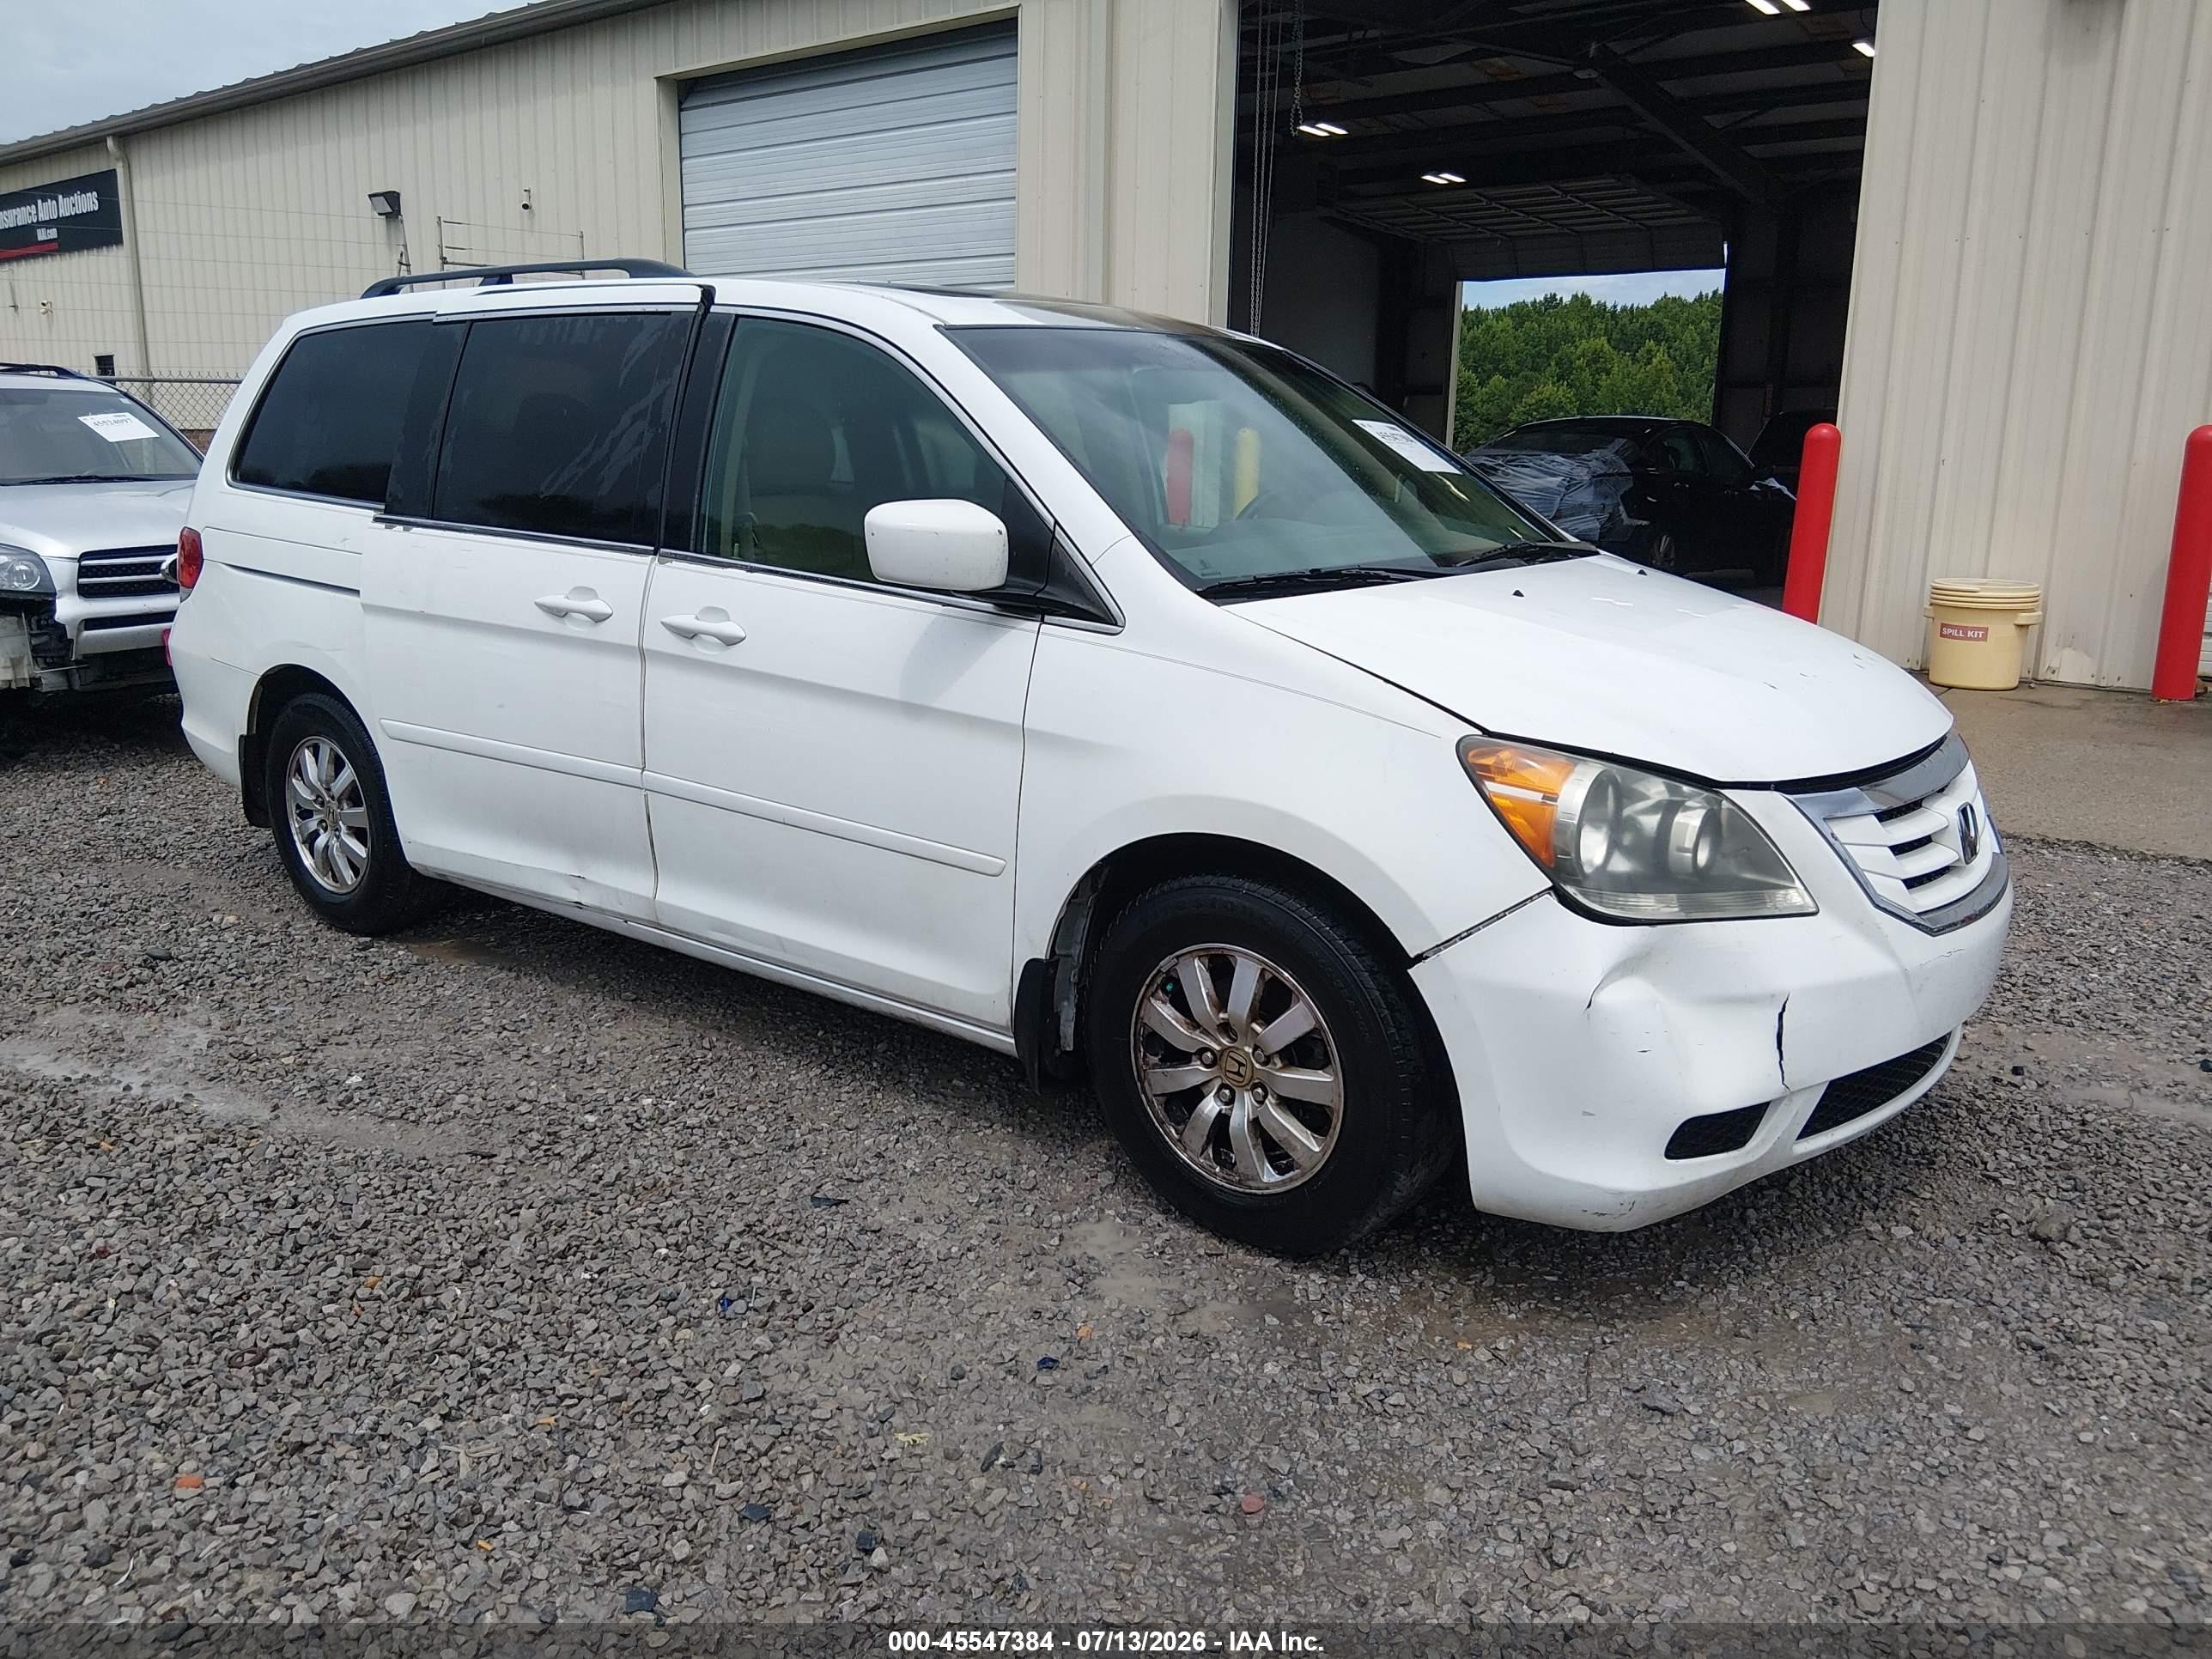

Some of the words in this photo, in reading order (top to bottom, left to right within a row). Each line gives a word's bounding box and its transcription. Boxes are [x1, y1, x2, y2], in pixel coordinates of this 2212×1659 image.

[0, 204, 37, 229] nsurance
[37, 198, 58, 222] Auto
[58, 191, 99, 217] Auctions
[1942, 627, 1965, 637] SPILL
